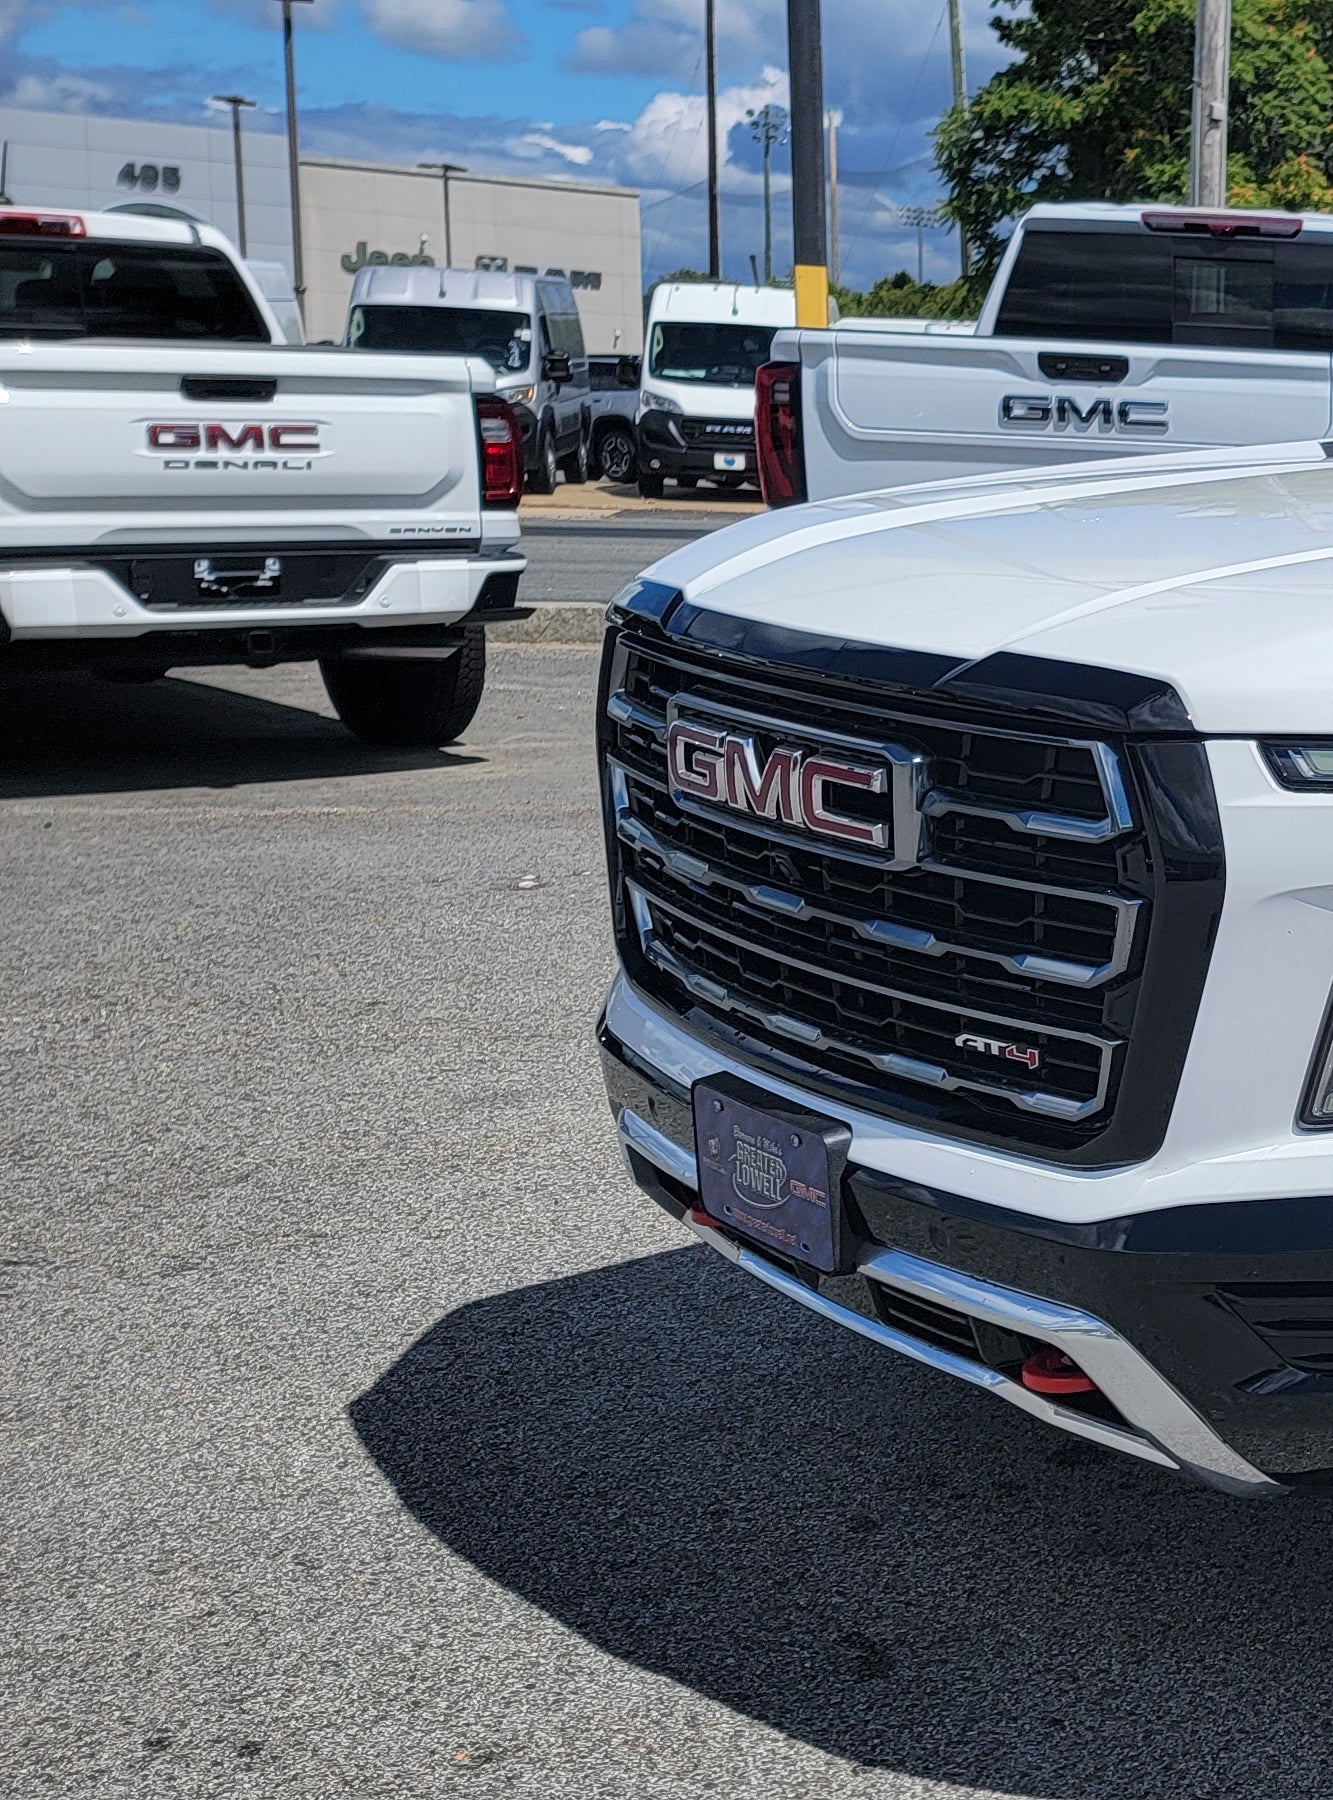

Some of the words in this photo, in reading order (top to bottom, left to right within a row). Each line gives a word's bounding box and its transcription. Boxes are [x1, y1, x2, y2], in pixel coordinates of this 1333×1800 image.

[705, 425, 752, 434] RAM
[998, 395, 1169, 433] GMC
[146, 423, 321, 452] GMC
[163, 460, 312, 471] DENALI
[669, 720, 888, 849] GMC
[954, 1033, 1039, 1069] AT4
[736, 1140, 785, 1178] GREATER
[735, 1160, 783, 1201] LOWELL
[789, 1179, 826, 1209] GMC
